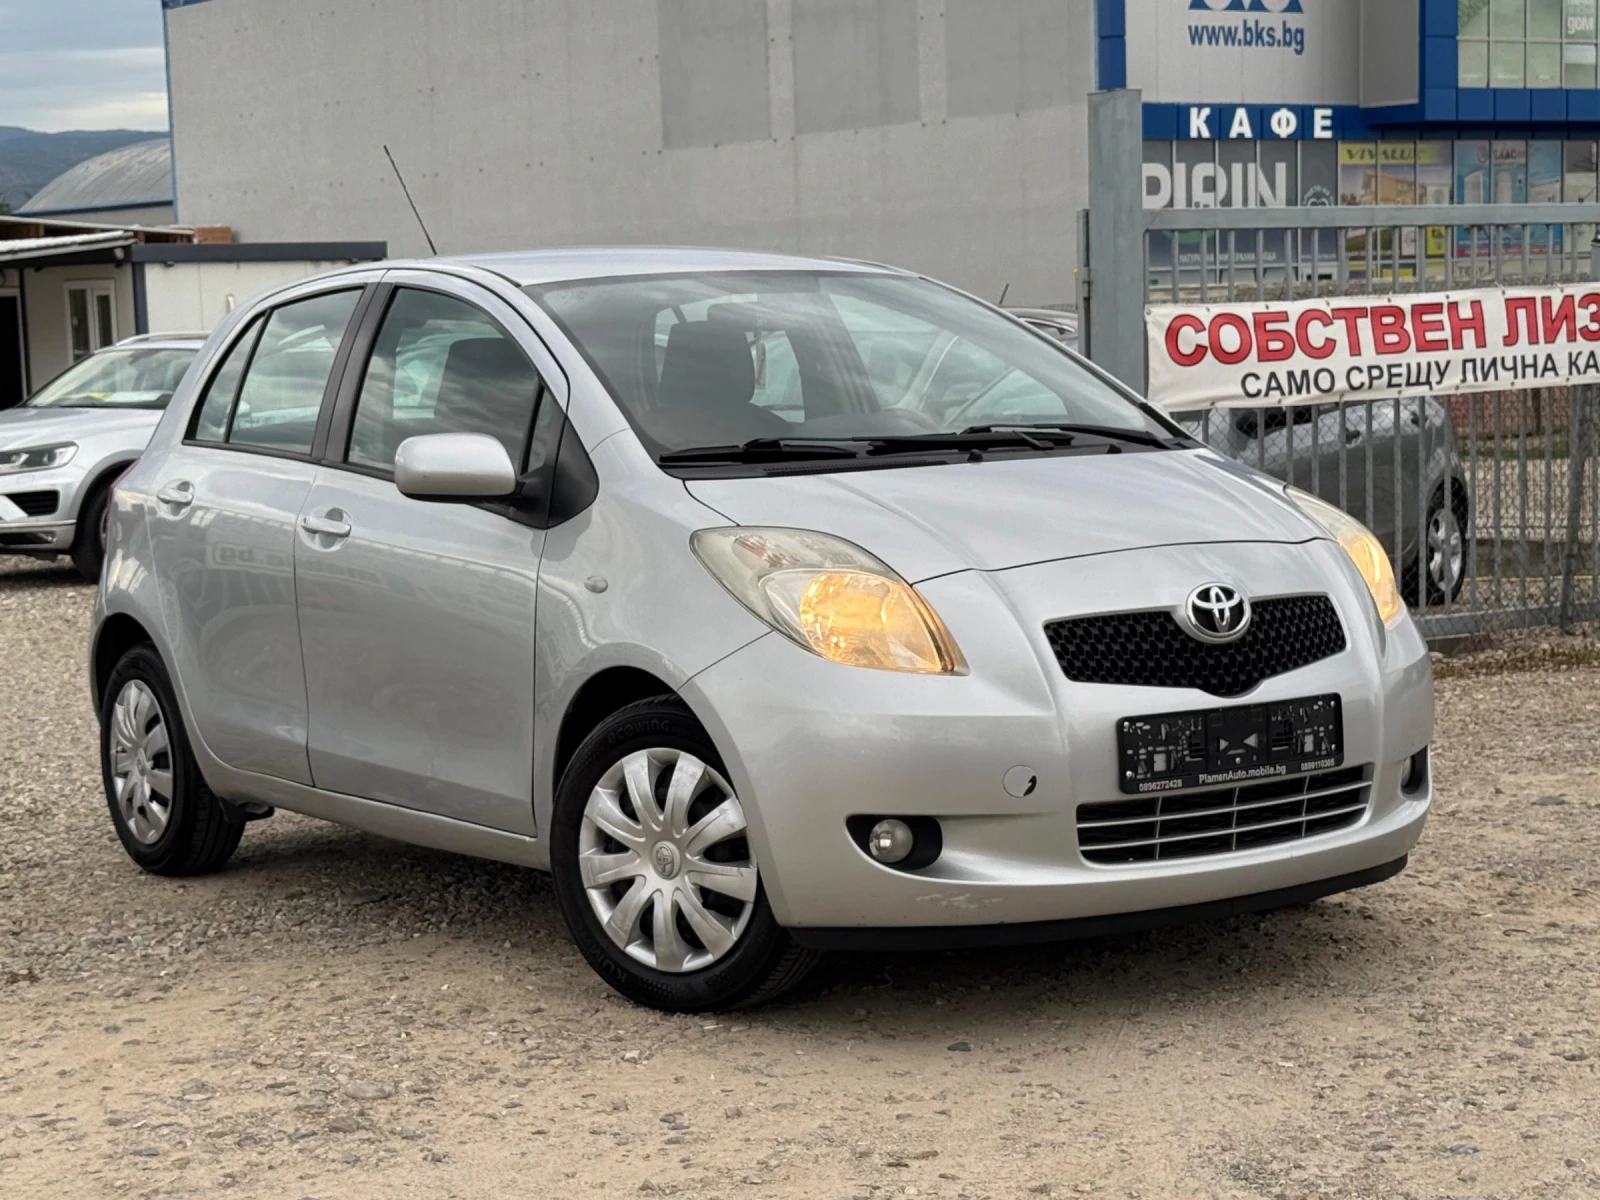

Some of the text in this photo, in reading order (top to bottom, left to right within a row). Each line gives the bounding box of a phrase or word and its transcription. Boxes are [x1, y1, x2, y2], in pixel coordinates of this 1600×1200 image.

[1188, 19, 1304, 56] www.bks.bg
[1189, 107, 1333, 139] КАФЕ
[1165, 292, 1600, 367] СОБСТВЕН ЛИЗ
[1241, 350, 1600, 398] САМО СРЕЩУ ЛИЧНА КА
[1199, 763, 1287, 784] PlamenAuto.mobile.bg
